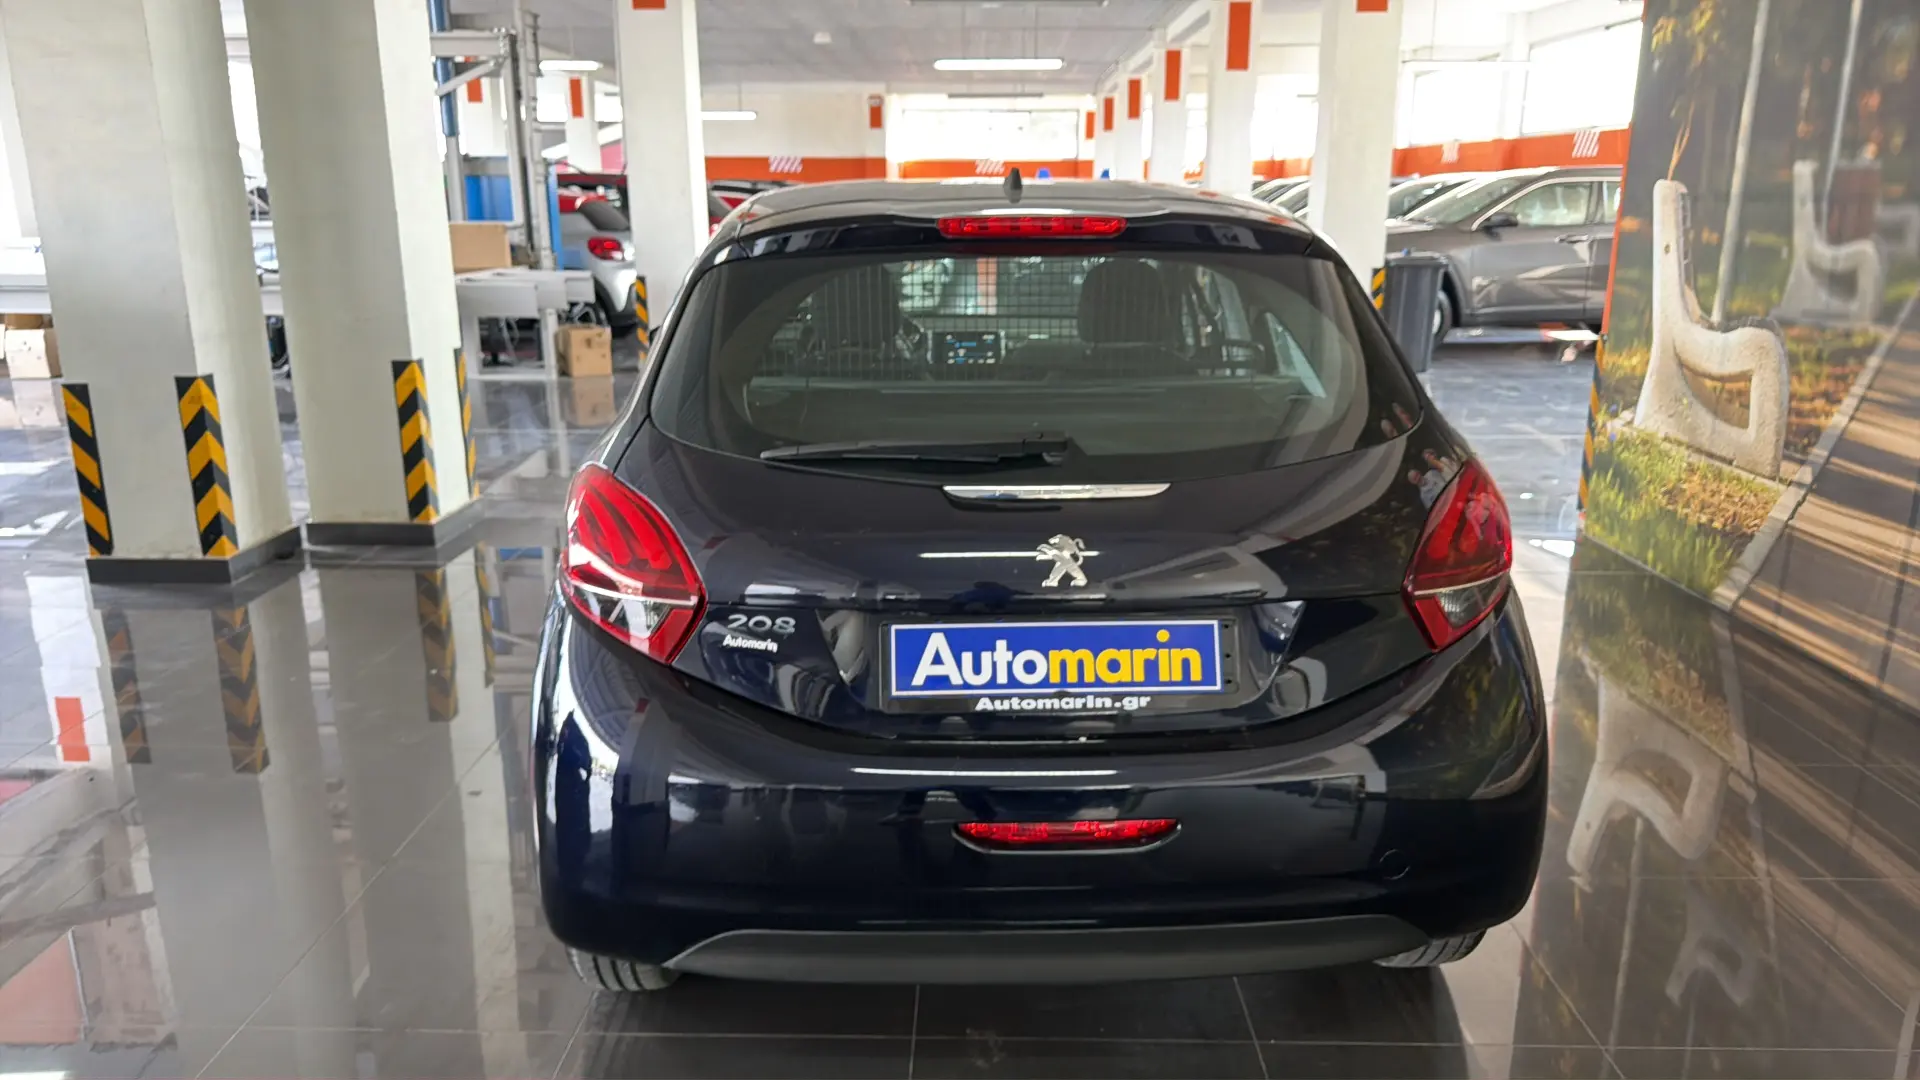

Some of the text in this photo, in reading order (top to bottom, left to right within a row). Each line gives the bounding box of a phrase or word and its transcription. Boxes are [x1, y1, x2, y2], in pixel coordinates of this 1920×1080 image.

[727, 613, 796, 635] 208
[722, 633, 779, 654] Automarin
[910, 629, 1202, 686] Automarin
[974, 695, 1151, 711] Automarin.gr
